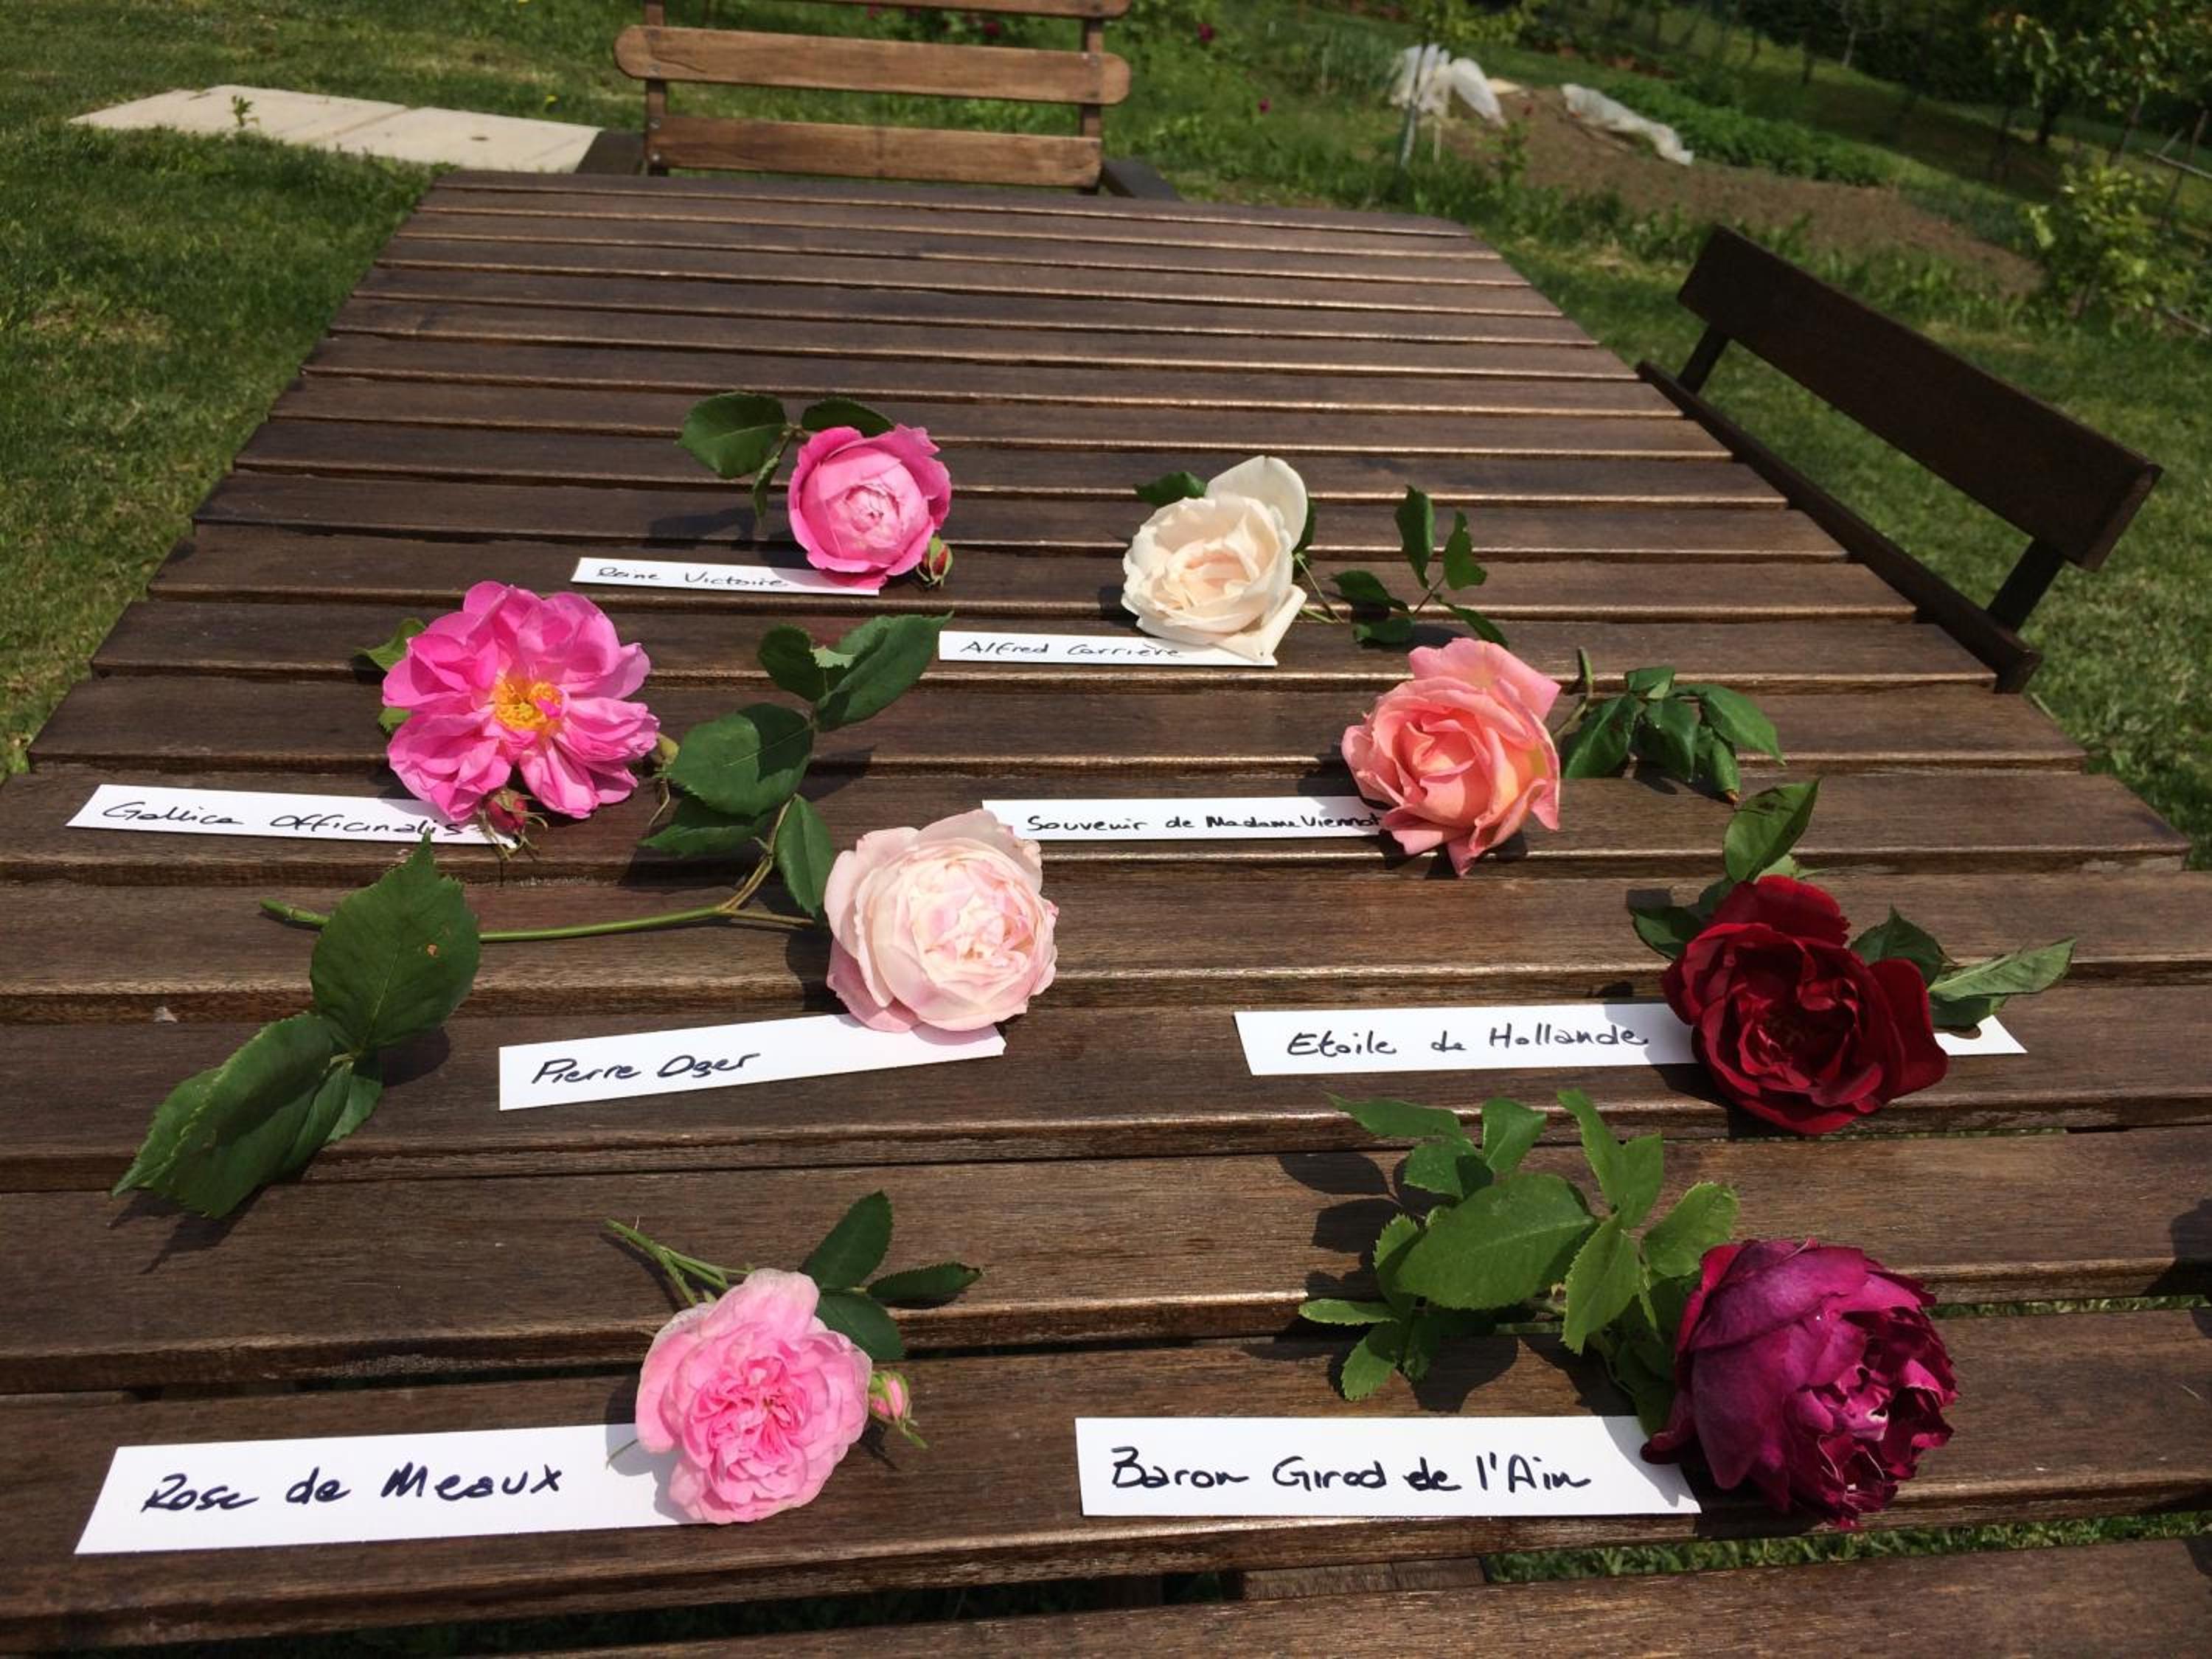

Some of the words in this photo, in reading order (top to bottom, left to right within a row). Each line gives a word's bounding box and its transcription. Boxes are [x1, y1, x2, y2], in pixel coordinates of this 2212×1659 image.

[597, 566, 661, 581] Reine
[684, 571, 788, 587] Victoire
[960, 641, 1049, 655] Alfred
[102, 801, 243, 825] Gallica
[1027, 815, 1147, 832] Souvenir
[1165, 816, 1193, 829] de
[1206, 815, 1301, 829] Madame
[1287, 1031, 1397, 1057] Etoile
[1431, 1031, 1466, 1051] de
[1489, 1023, 1649, 1048] Hollande
[532, 1057, 640, 1084] Pierre
[657, 1052, 761, 1079] Oger
[1110, 1446, 1248, 1489] Baron
[1273, 1455, 1387, 1491] Girod
[1402, 1455, 1463, 1492] de
[1478, 1451, 1593, 1492] l'Ain
[140, 1472, 260, 1513] Rose
[285, 1467, 352, 1504] de
[380, 1461, 563, 1498] Meaux
